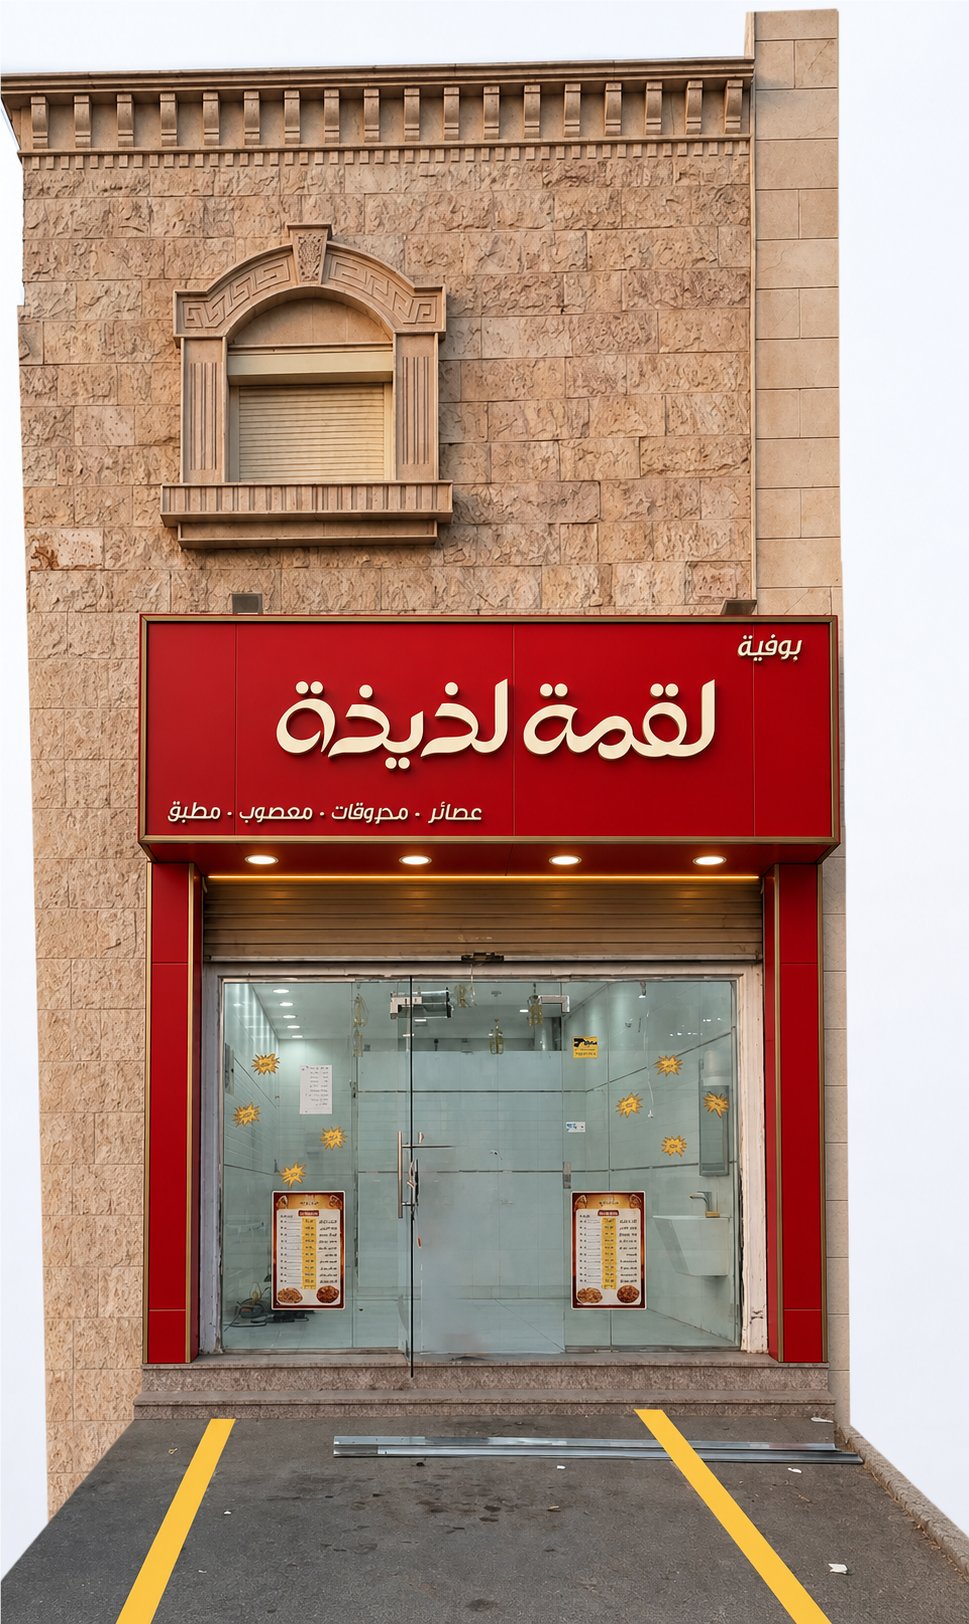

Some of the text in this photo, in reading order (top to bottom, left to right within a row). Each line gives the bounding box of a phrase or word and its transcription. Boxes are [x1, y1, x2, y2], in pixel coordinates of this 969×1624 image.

[737, 633, 803, 662] بوفية
[276, 678, 716, 770] لقمة لذيذة
[167, 800, 221, 824] مطبق
[239, 805, 313, 824] معصوب
[427, 800, 483, 824] عصائر
